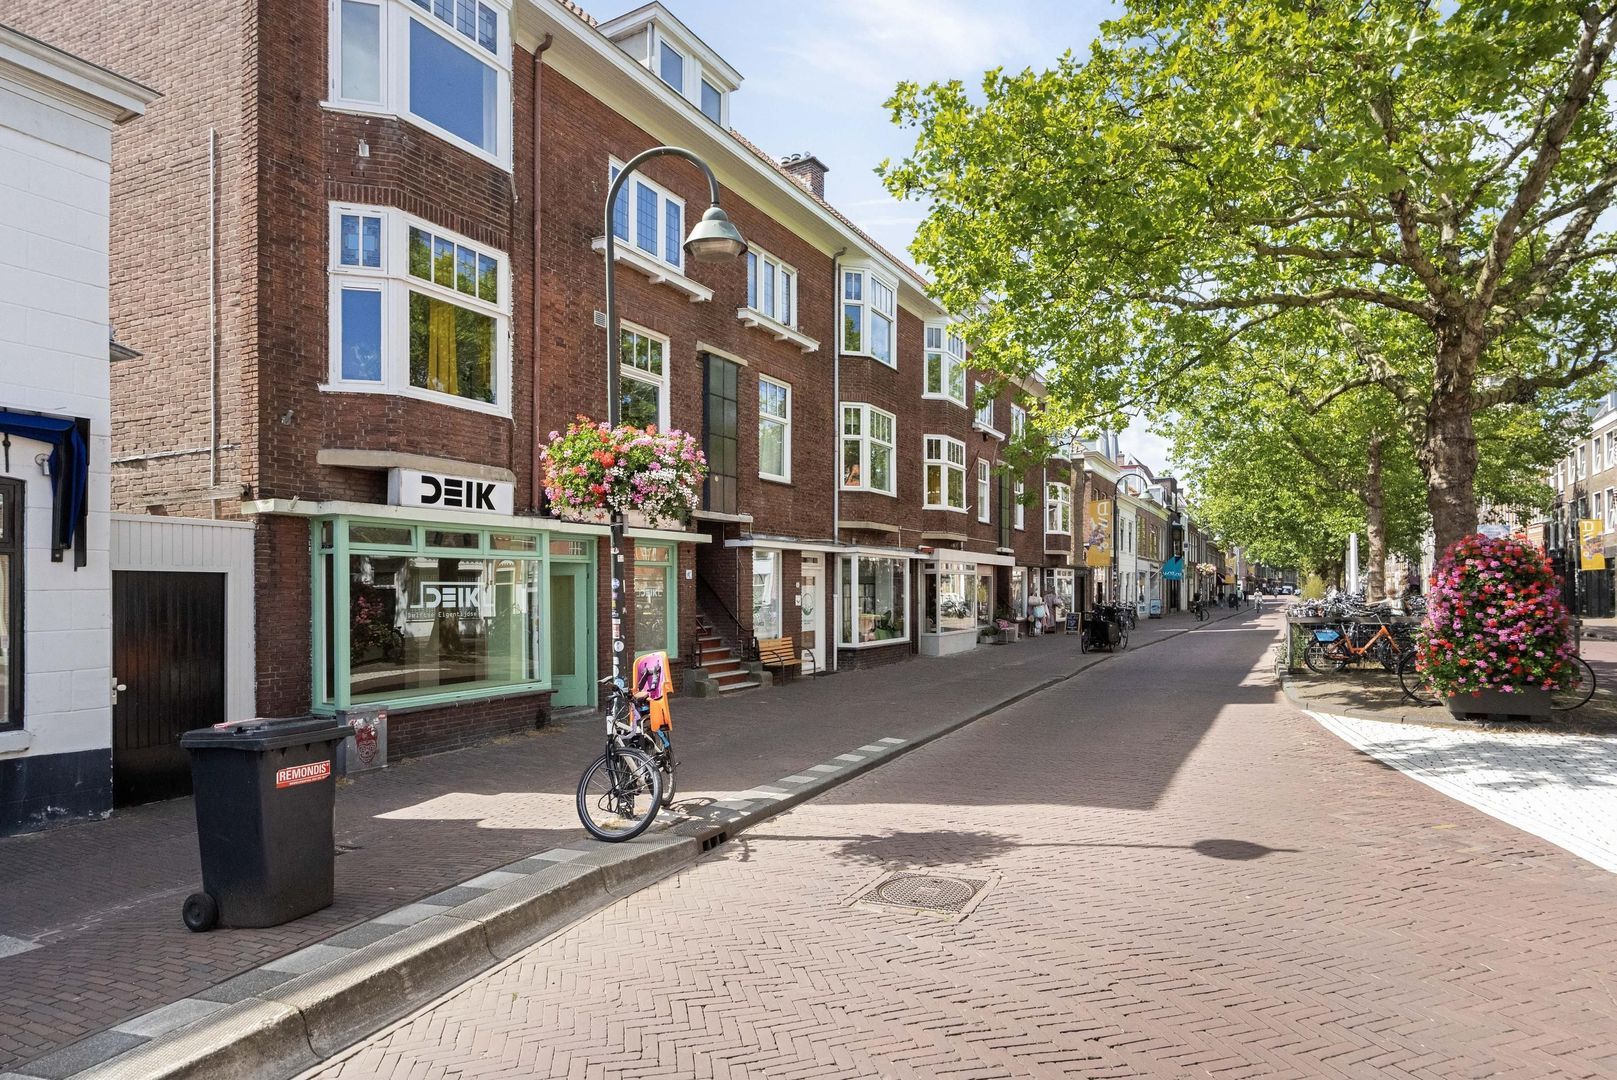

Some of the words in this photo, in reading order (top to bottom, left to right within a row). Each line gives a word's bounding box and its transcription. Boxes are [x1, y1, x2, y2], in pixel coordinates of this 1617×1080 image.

[421, 475, 496, 510] DEIK
[425, 587, 481, 608] DEIK
[279, 763, 327, 781] REMONDIS
